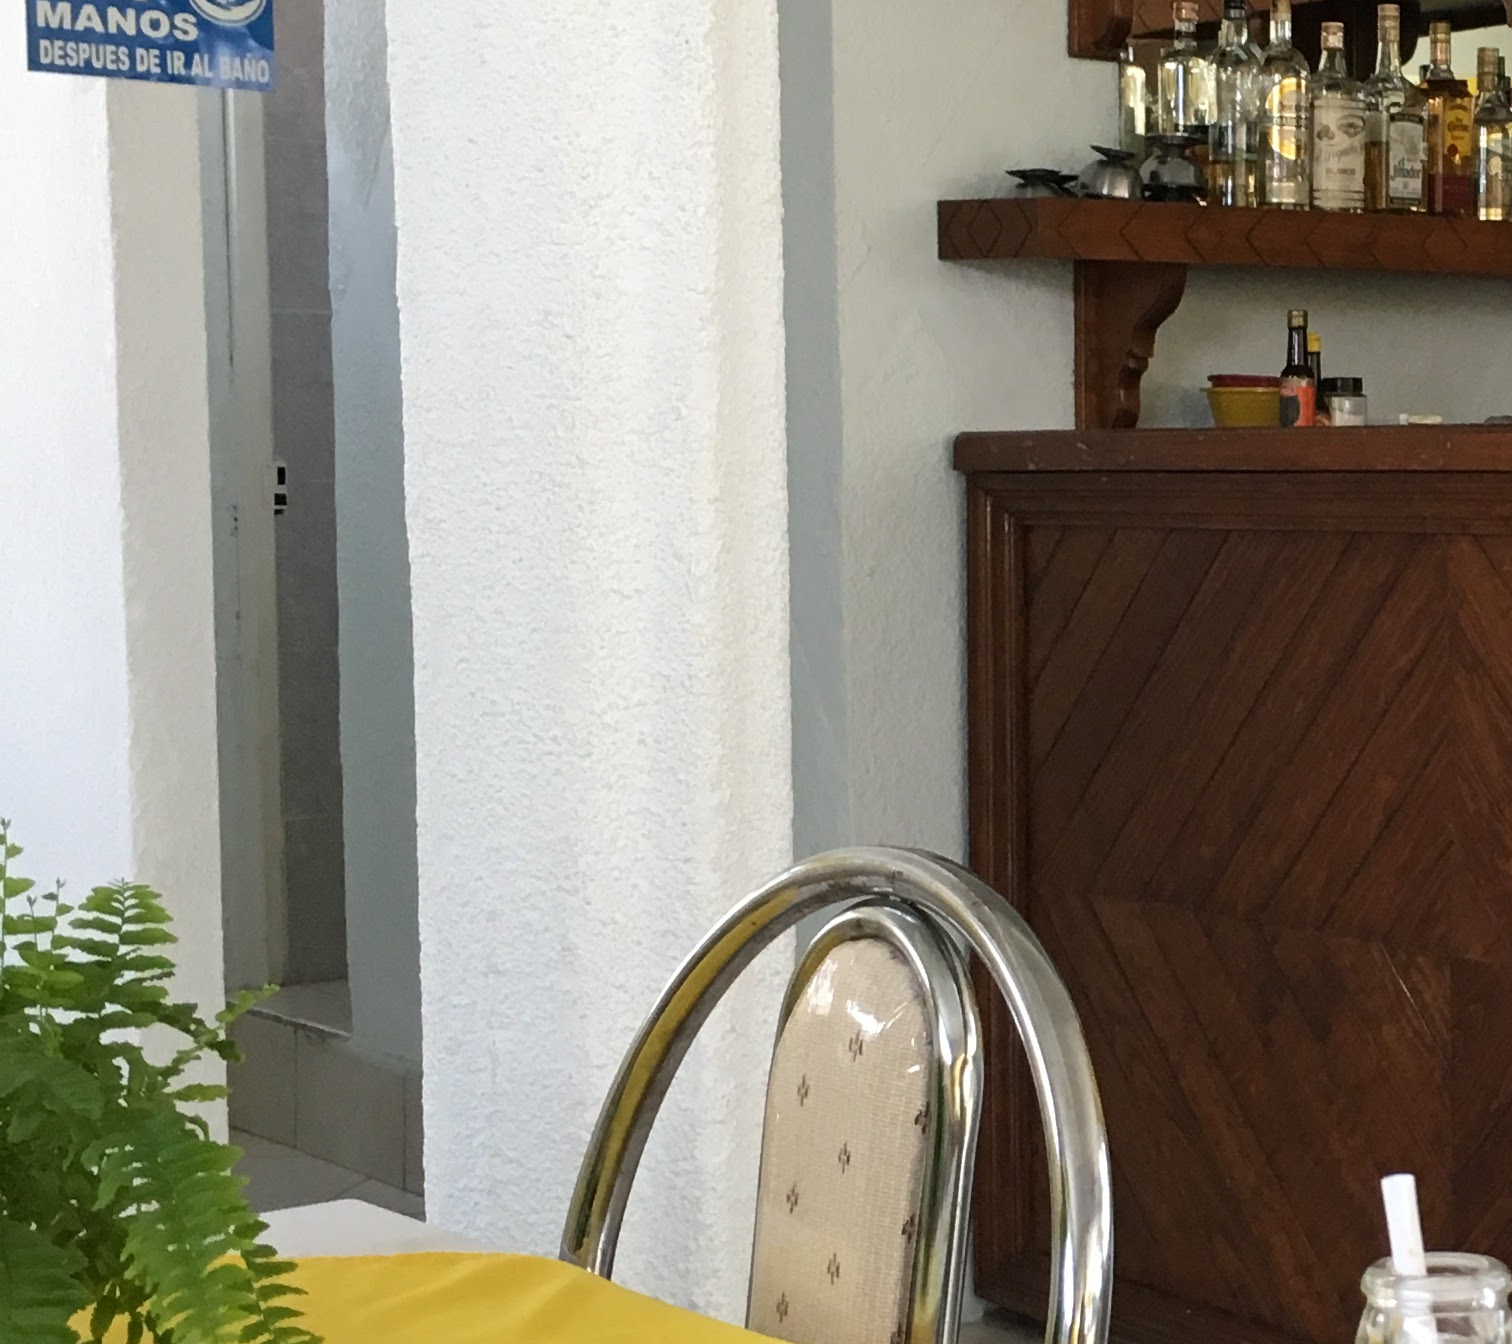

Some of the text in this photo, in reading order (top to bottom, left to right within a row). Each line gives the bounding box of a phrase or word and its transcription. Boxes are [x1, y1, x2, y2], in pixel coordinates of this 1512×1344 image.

[36, 0, 198, 41] MANOS
[40, 39, 130, 72] DESPUES
[136, 47, 161, 74] DE
[166, 50, 186, 75] IR
[191, 54, 213, 79] AL
